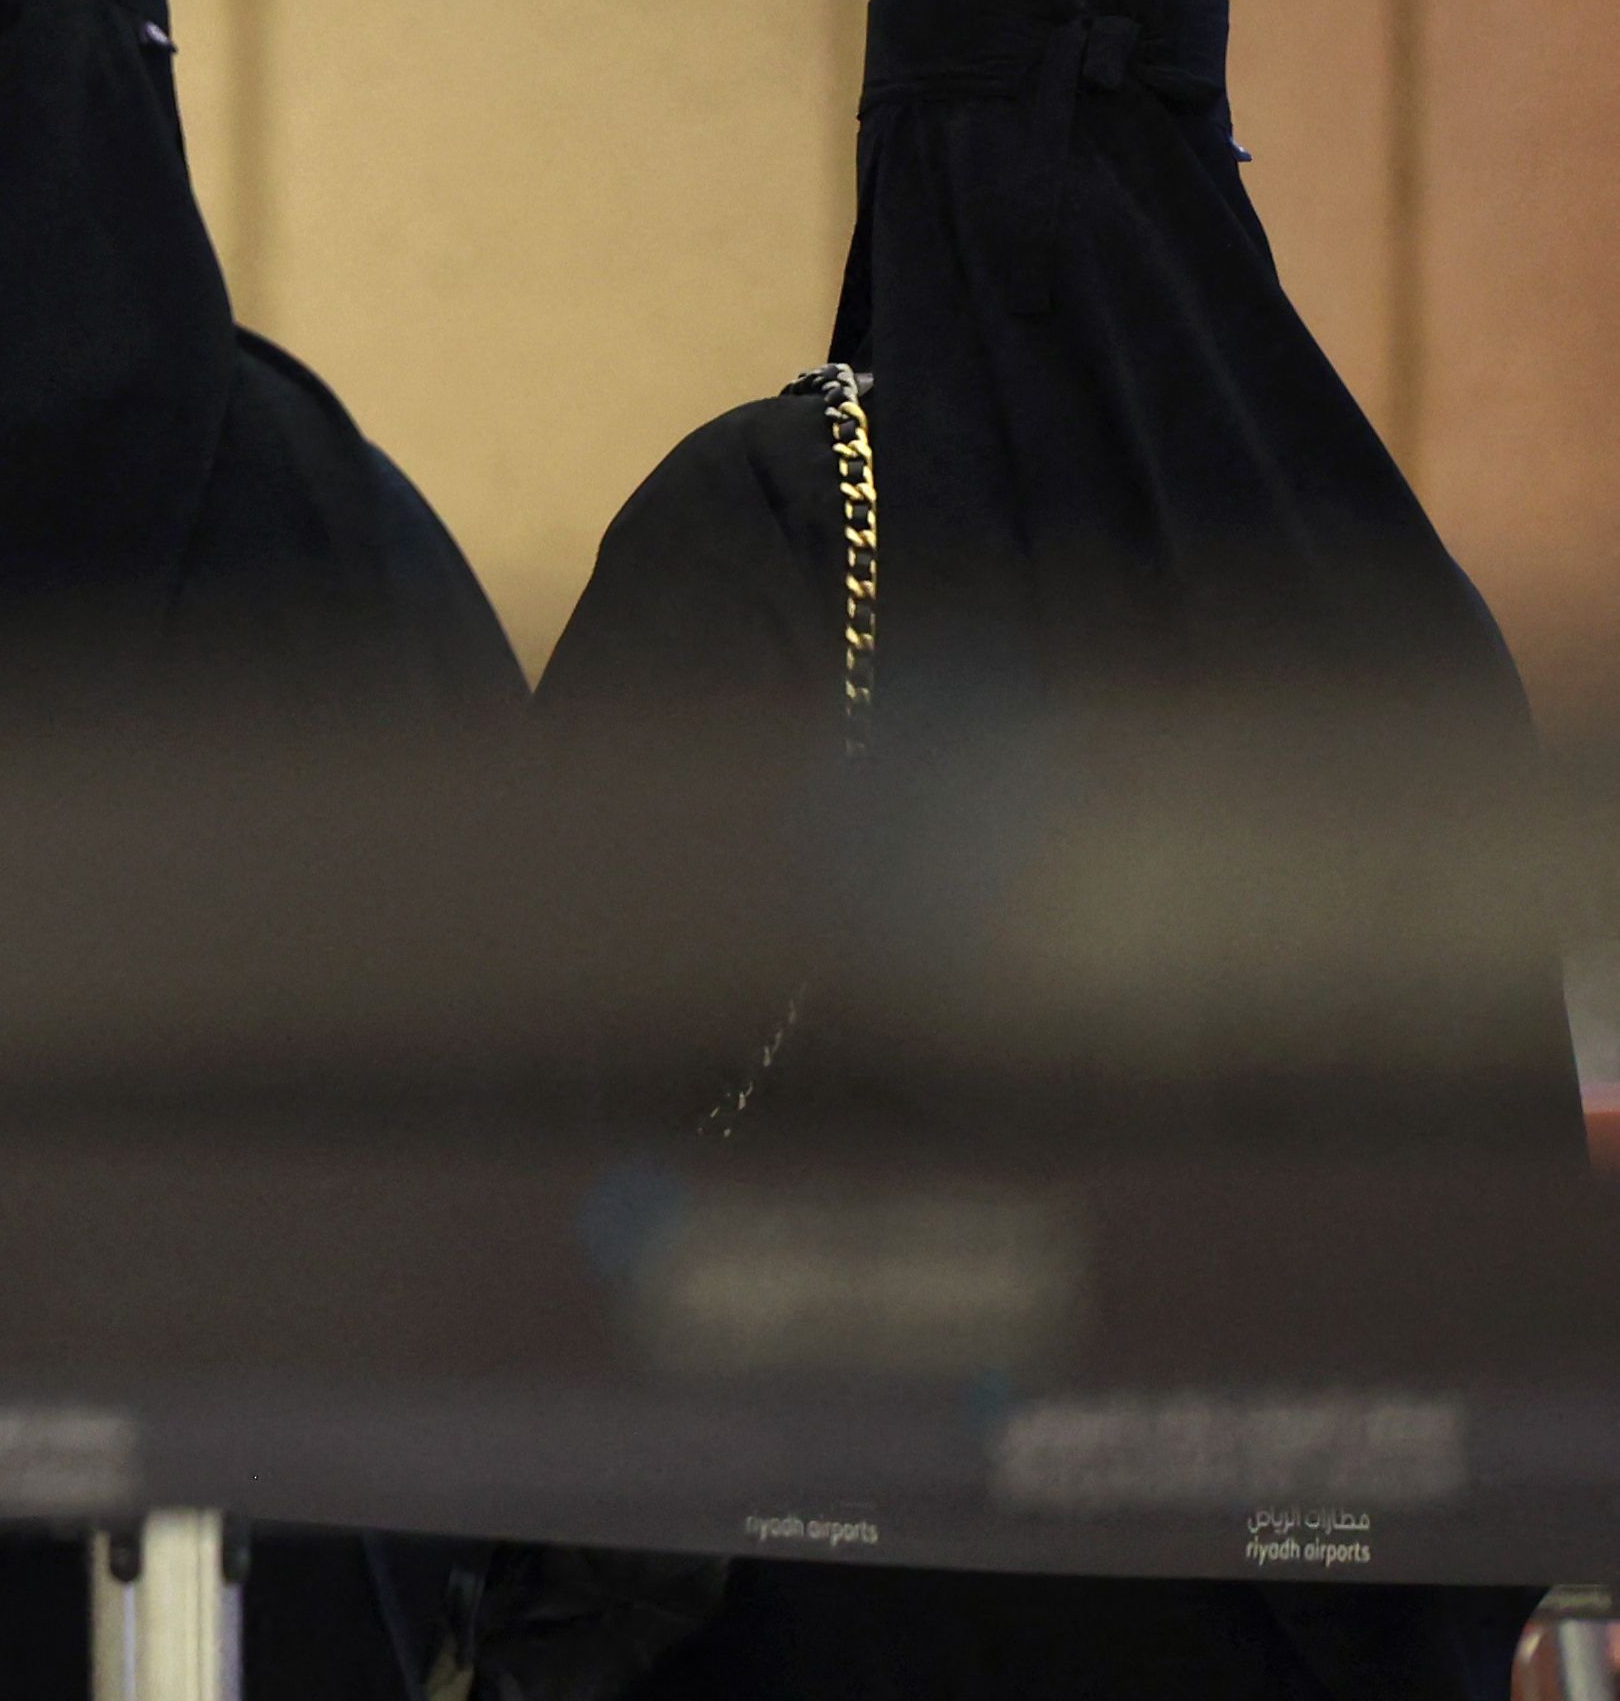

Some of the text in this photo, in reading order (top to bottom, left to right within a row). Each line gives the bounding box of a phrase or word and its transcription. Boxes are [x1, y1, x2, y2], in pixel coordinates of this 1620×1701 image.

[745, 1510, 879, 1547] riyadh airports
[1246, 1536, 1370, 1567] riyadh airports
